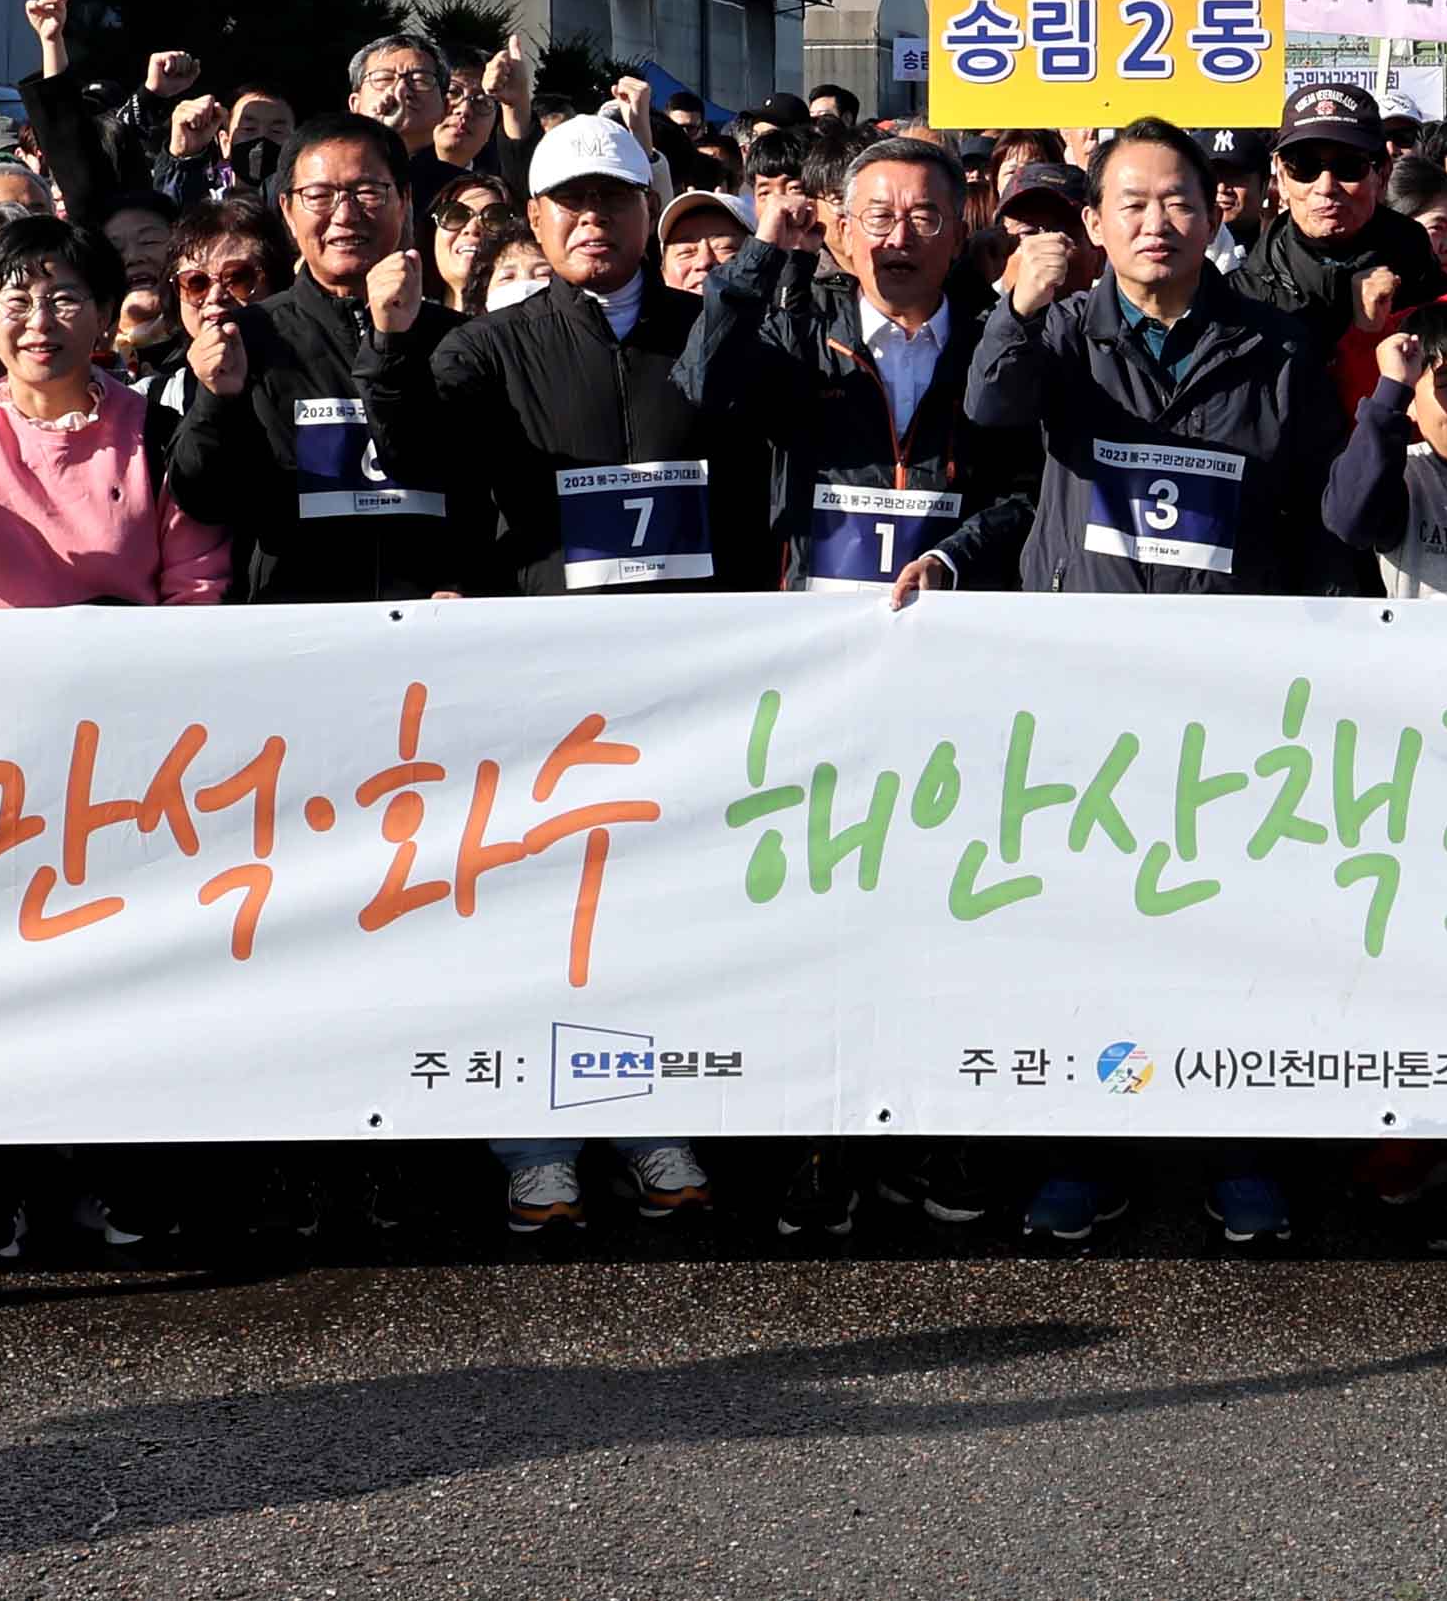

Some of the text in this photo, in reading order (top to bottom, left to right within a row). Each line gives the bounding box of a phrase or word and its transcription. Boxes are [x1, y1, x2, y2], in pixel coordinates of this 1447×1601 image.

[303, 406, 333, 419] 2023
[1099, 447, 1128, 463] 2023
[1152, 453, 1237, 475] 구민건강걷기대회
[564, 476, 595, 489] 2023
[1144, 478, 1179, 531] 3
[623, 497, 654, 547] 7
[875, 522, 895, 573] 1
[570, 1050, 743, 1079] 인천일보
